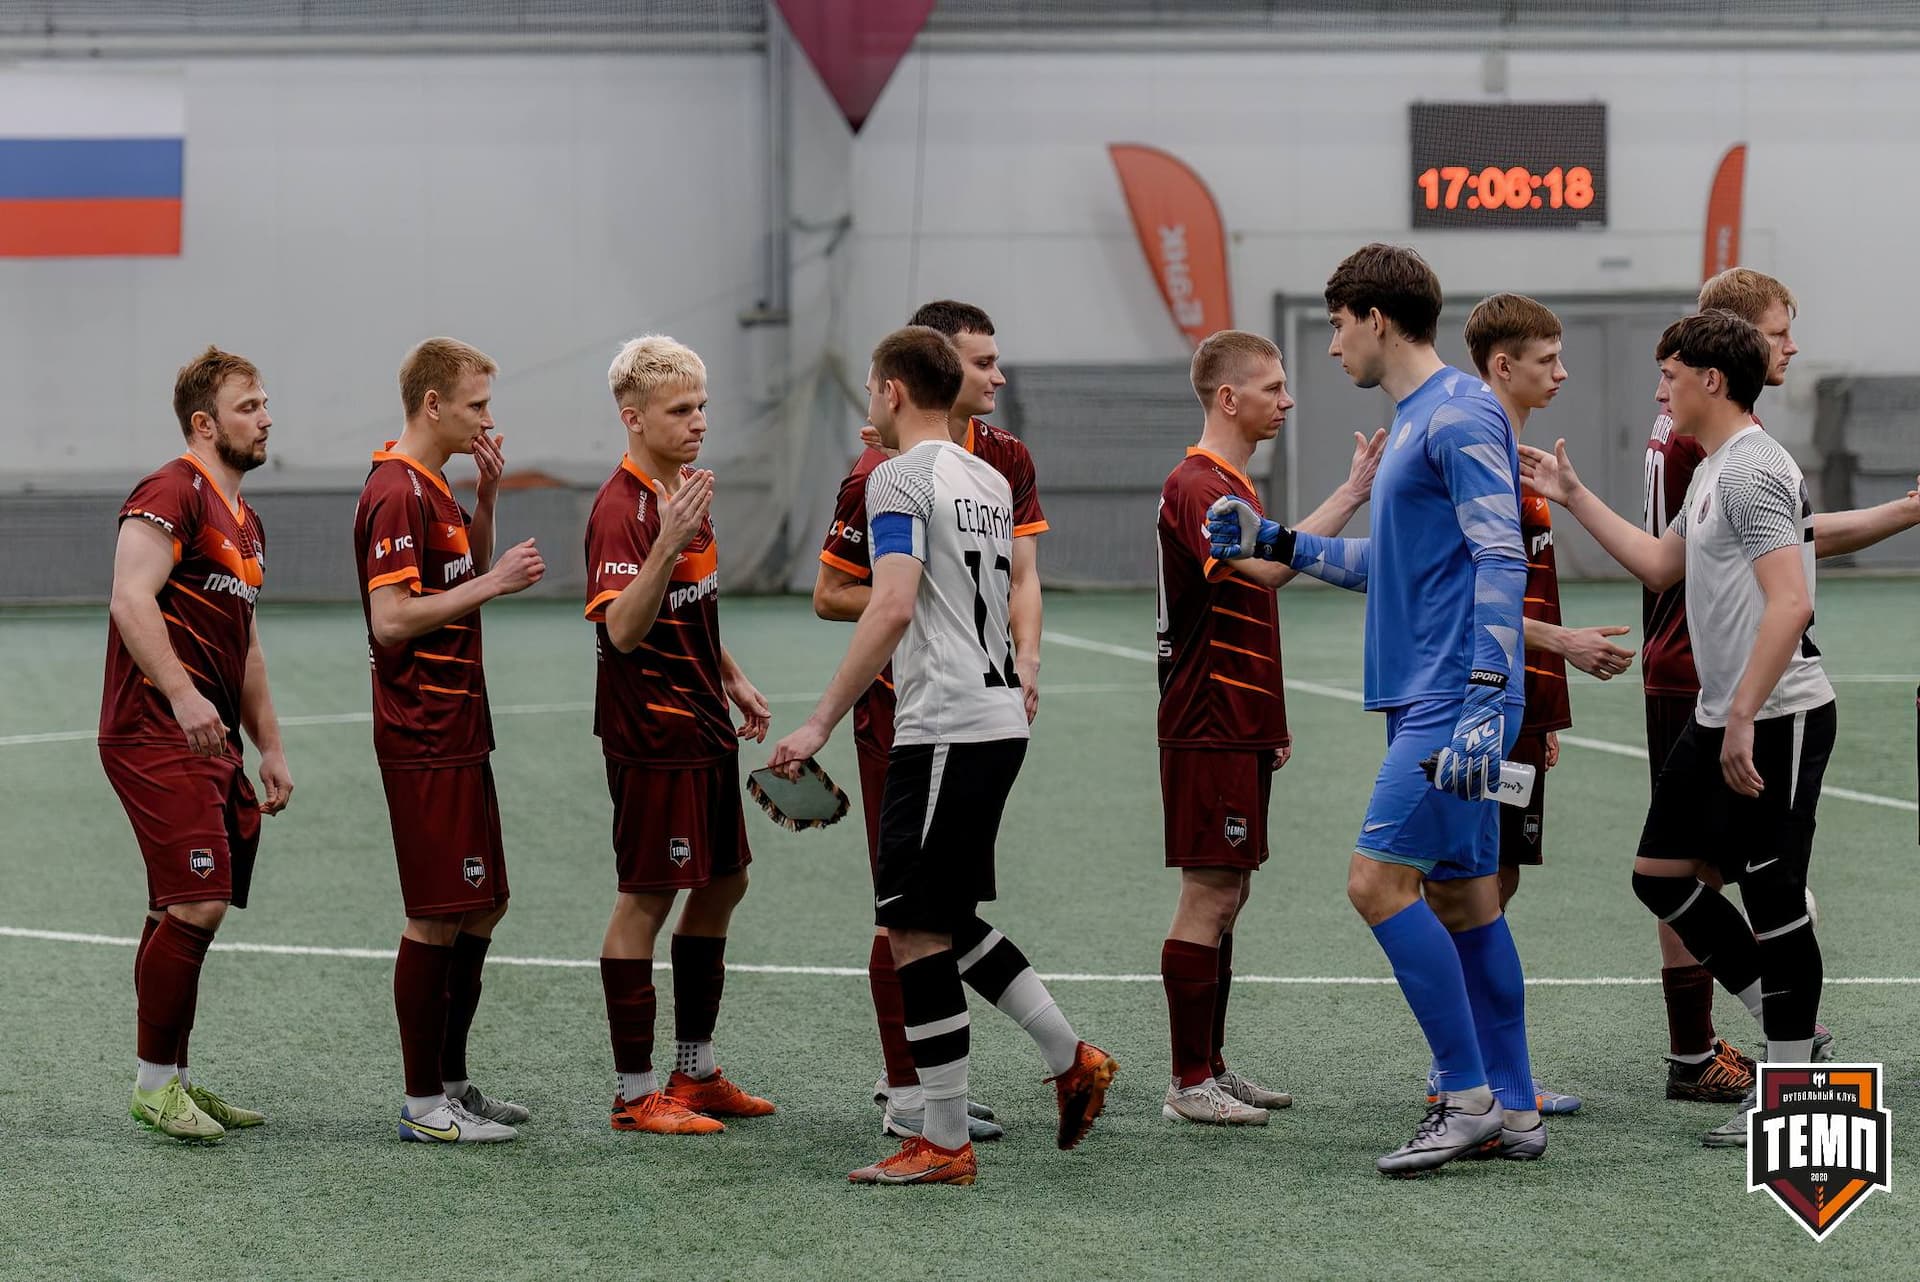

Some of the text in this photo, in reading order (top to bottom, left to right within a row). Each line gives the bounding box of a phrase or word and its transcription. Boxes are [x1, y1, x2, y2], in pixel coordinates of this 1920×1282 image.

[1418, 166, 1595, 209] 17:06:18
[604, 562, 638, 575] ПСБ
[1470, 671, 1504, 683] SPORT
